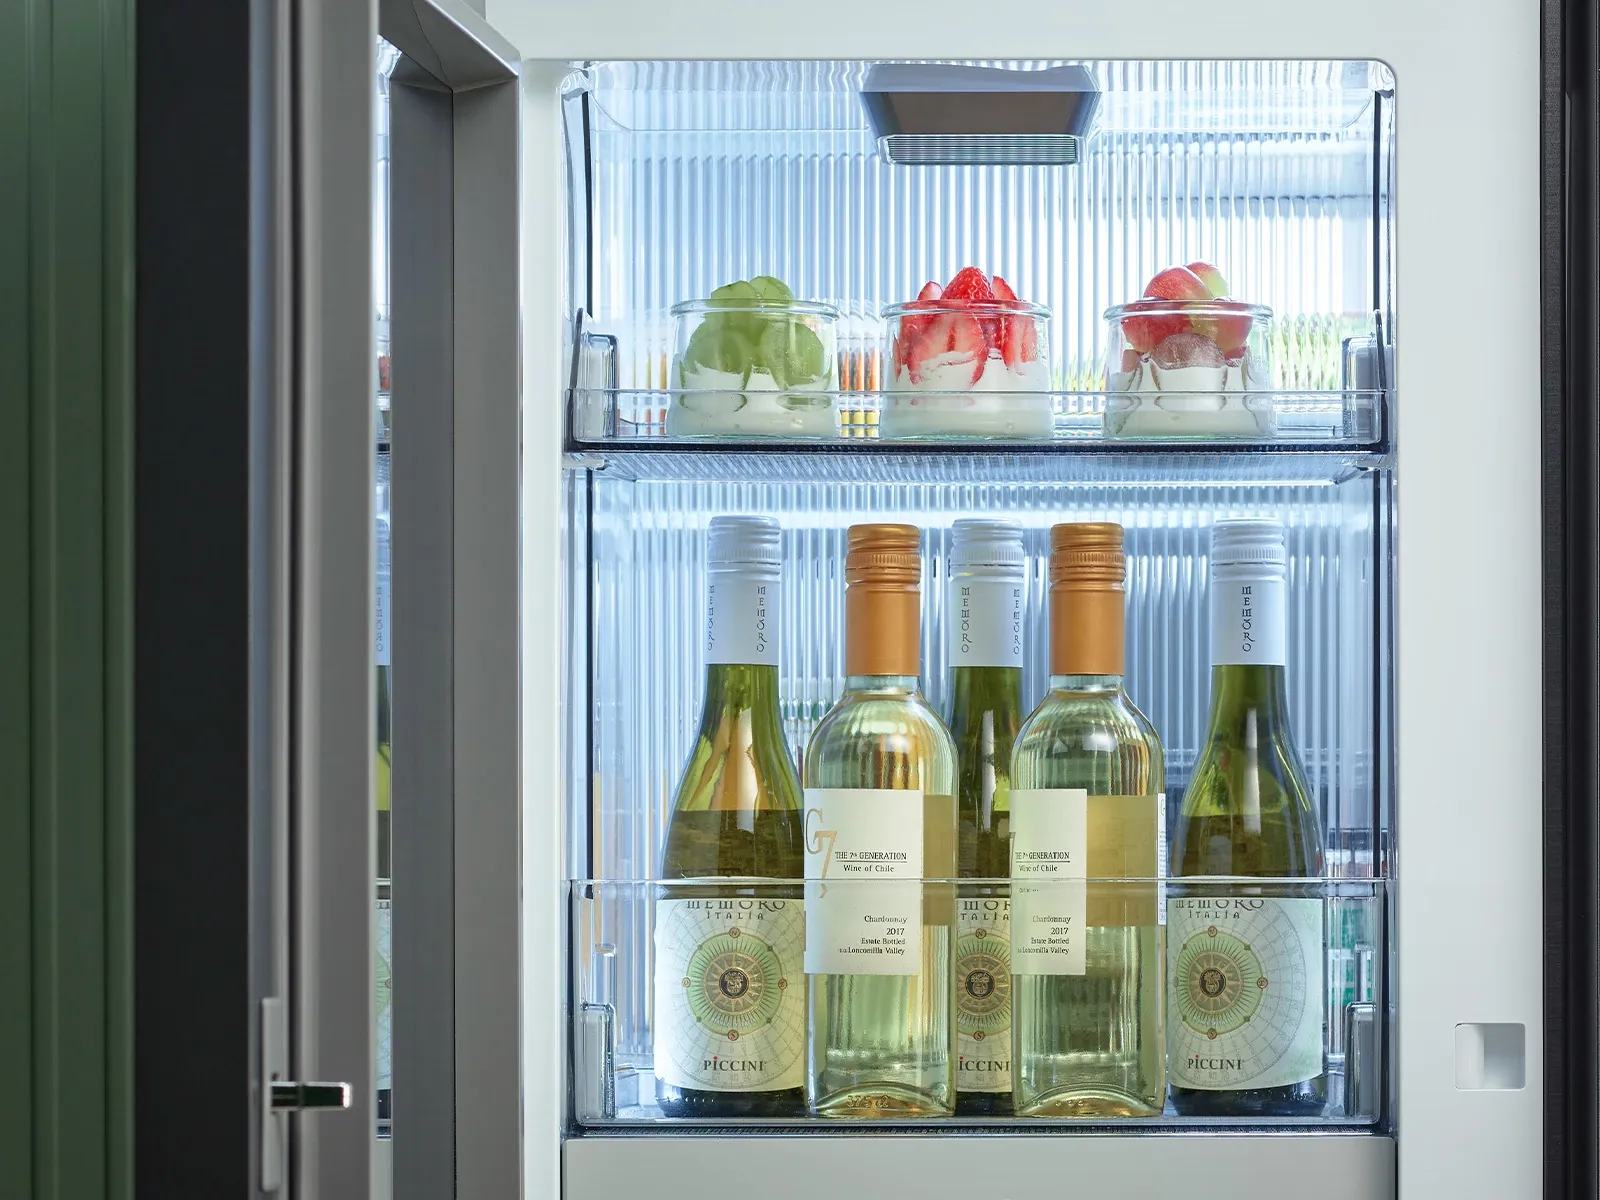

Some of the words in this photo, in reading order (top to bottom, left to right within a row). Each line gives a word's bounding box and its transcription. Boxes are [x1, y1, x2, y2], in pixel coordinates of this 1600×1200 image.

[961, 586, 972, 653] MEMORO
[1242, 586, 1255, 652] MEMORO
[835, 851, 848, 860] THE
[859, 851, 907, 860] GENERATION
[1029, 851, 1070, 860] GENERATION
[843, 864, 862, 872] Wine
[864, 864, 873, 872] of
[875, 864, 895, 872] Chile
[1032, 864, 1040, 872] of
[1041, 864, 1058, 872] Chile
[706, 911, 764, 920] ITALIA
[960, 912, 1010, 920] TALIA
[1188, 910, 1241, 919] ITALIA
[864, 915, 908, 924] Chardonnay
[886, 927, 905, 936] 2017
[1050, 927, 1069, 935] 2017
[861, 937, 880, 945] Estate
[882, 937, 906, 945] Bottled
[1048, 937, 1070, 945] Bottled
[885, 946, 906, 955] Valley
[1050, 946, 1070, 955] Valley
